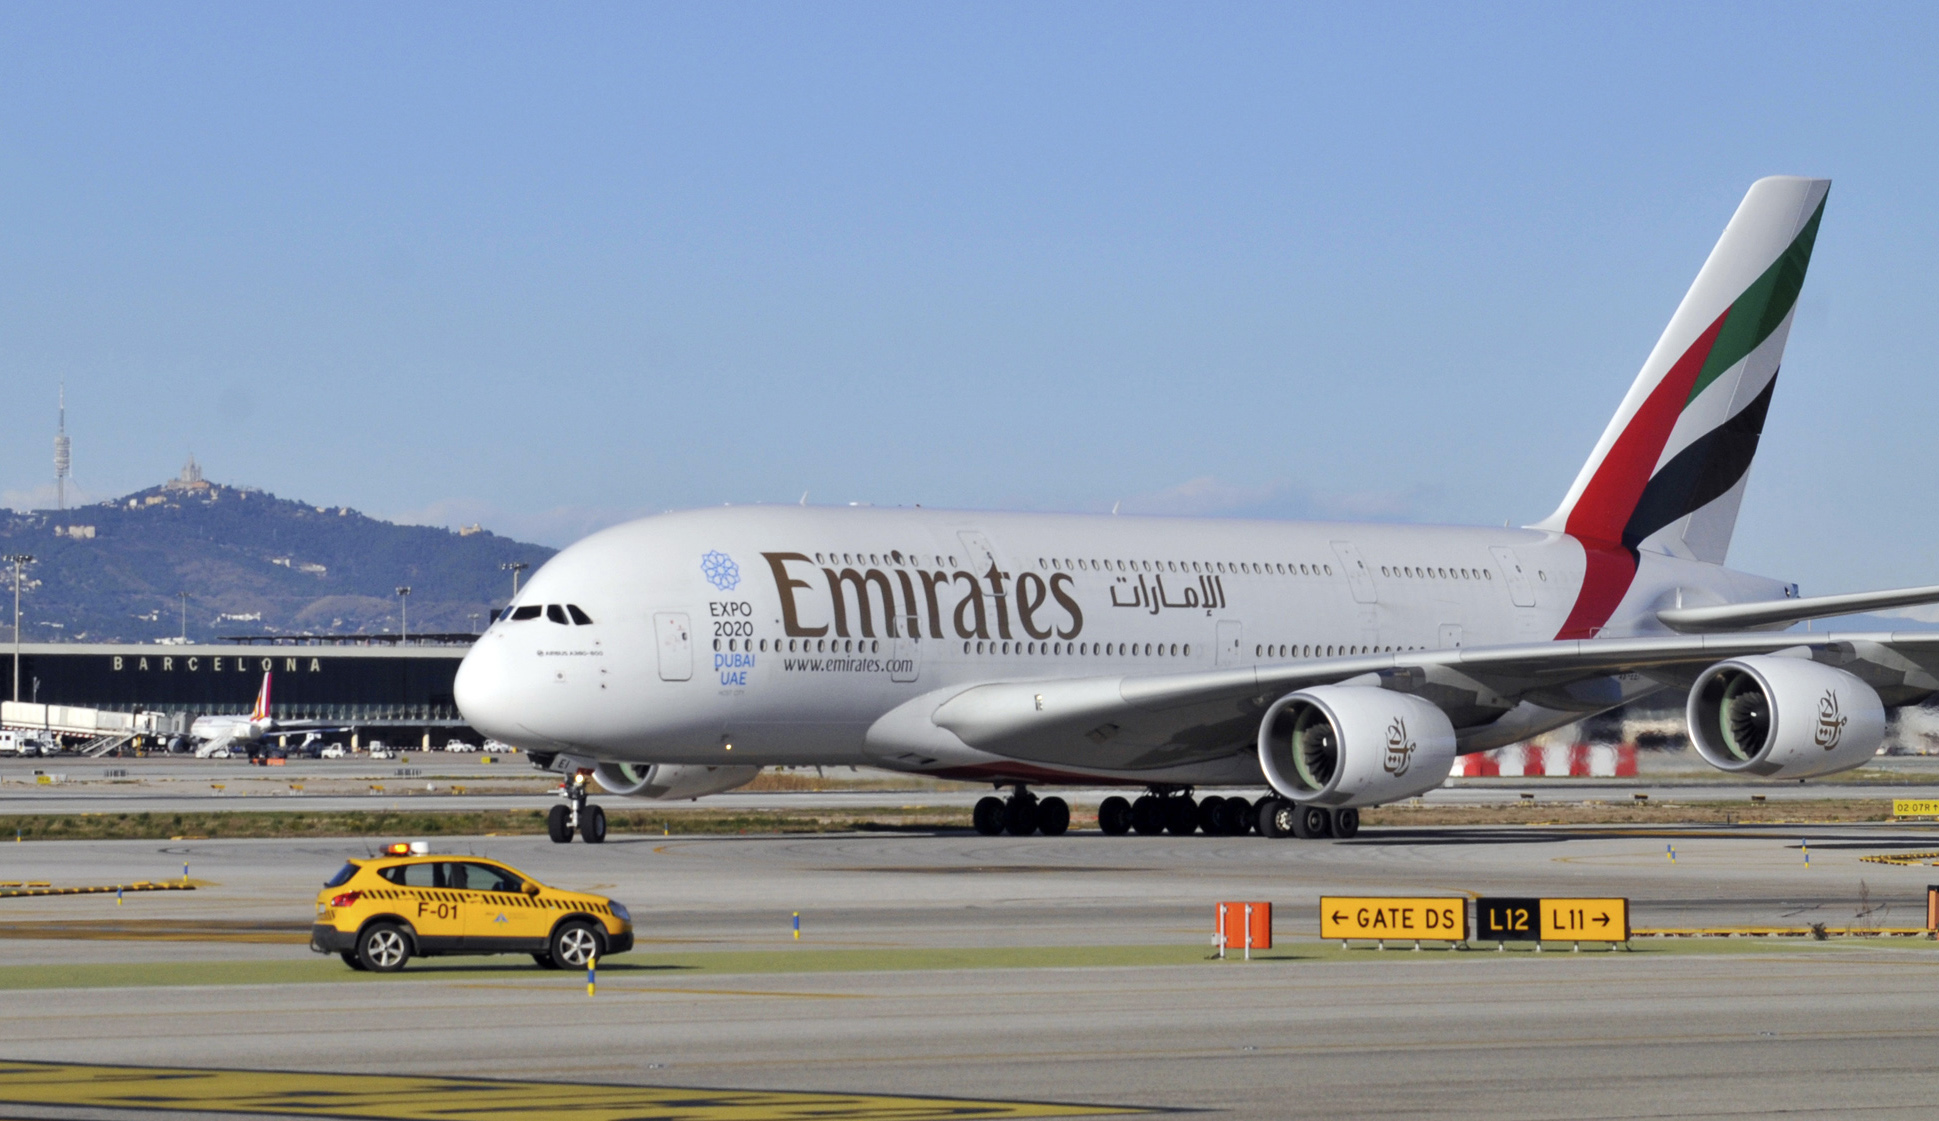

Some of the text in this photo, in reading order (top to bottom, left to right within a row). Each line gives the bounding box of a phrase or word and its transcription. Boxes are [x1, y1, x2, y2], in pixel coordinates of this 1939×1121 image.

[760, 550, 1084, 640] Emirates
[709, 601, 752, 617] EXPO
[713, 620, 754, 637] 2020
[113, 656, 320, 671] BARCELONA
[714, 653, 755, 667] DUBAI
[784, 657, 913, 673] www.emirates.com
[721, 671, 747, 685] UAE
[1897, 804, 1931, 812] 02 07R
[418, 902, 458, 920] F-01
[1357, 908, 1455, 929] GATE DS
[1489, 908, 1530, 930] L12
[1553, 909, 1584, 930] L11
